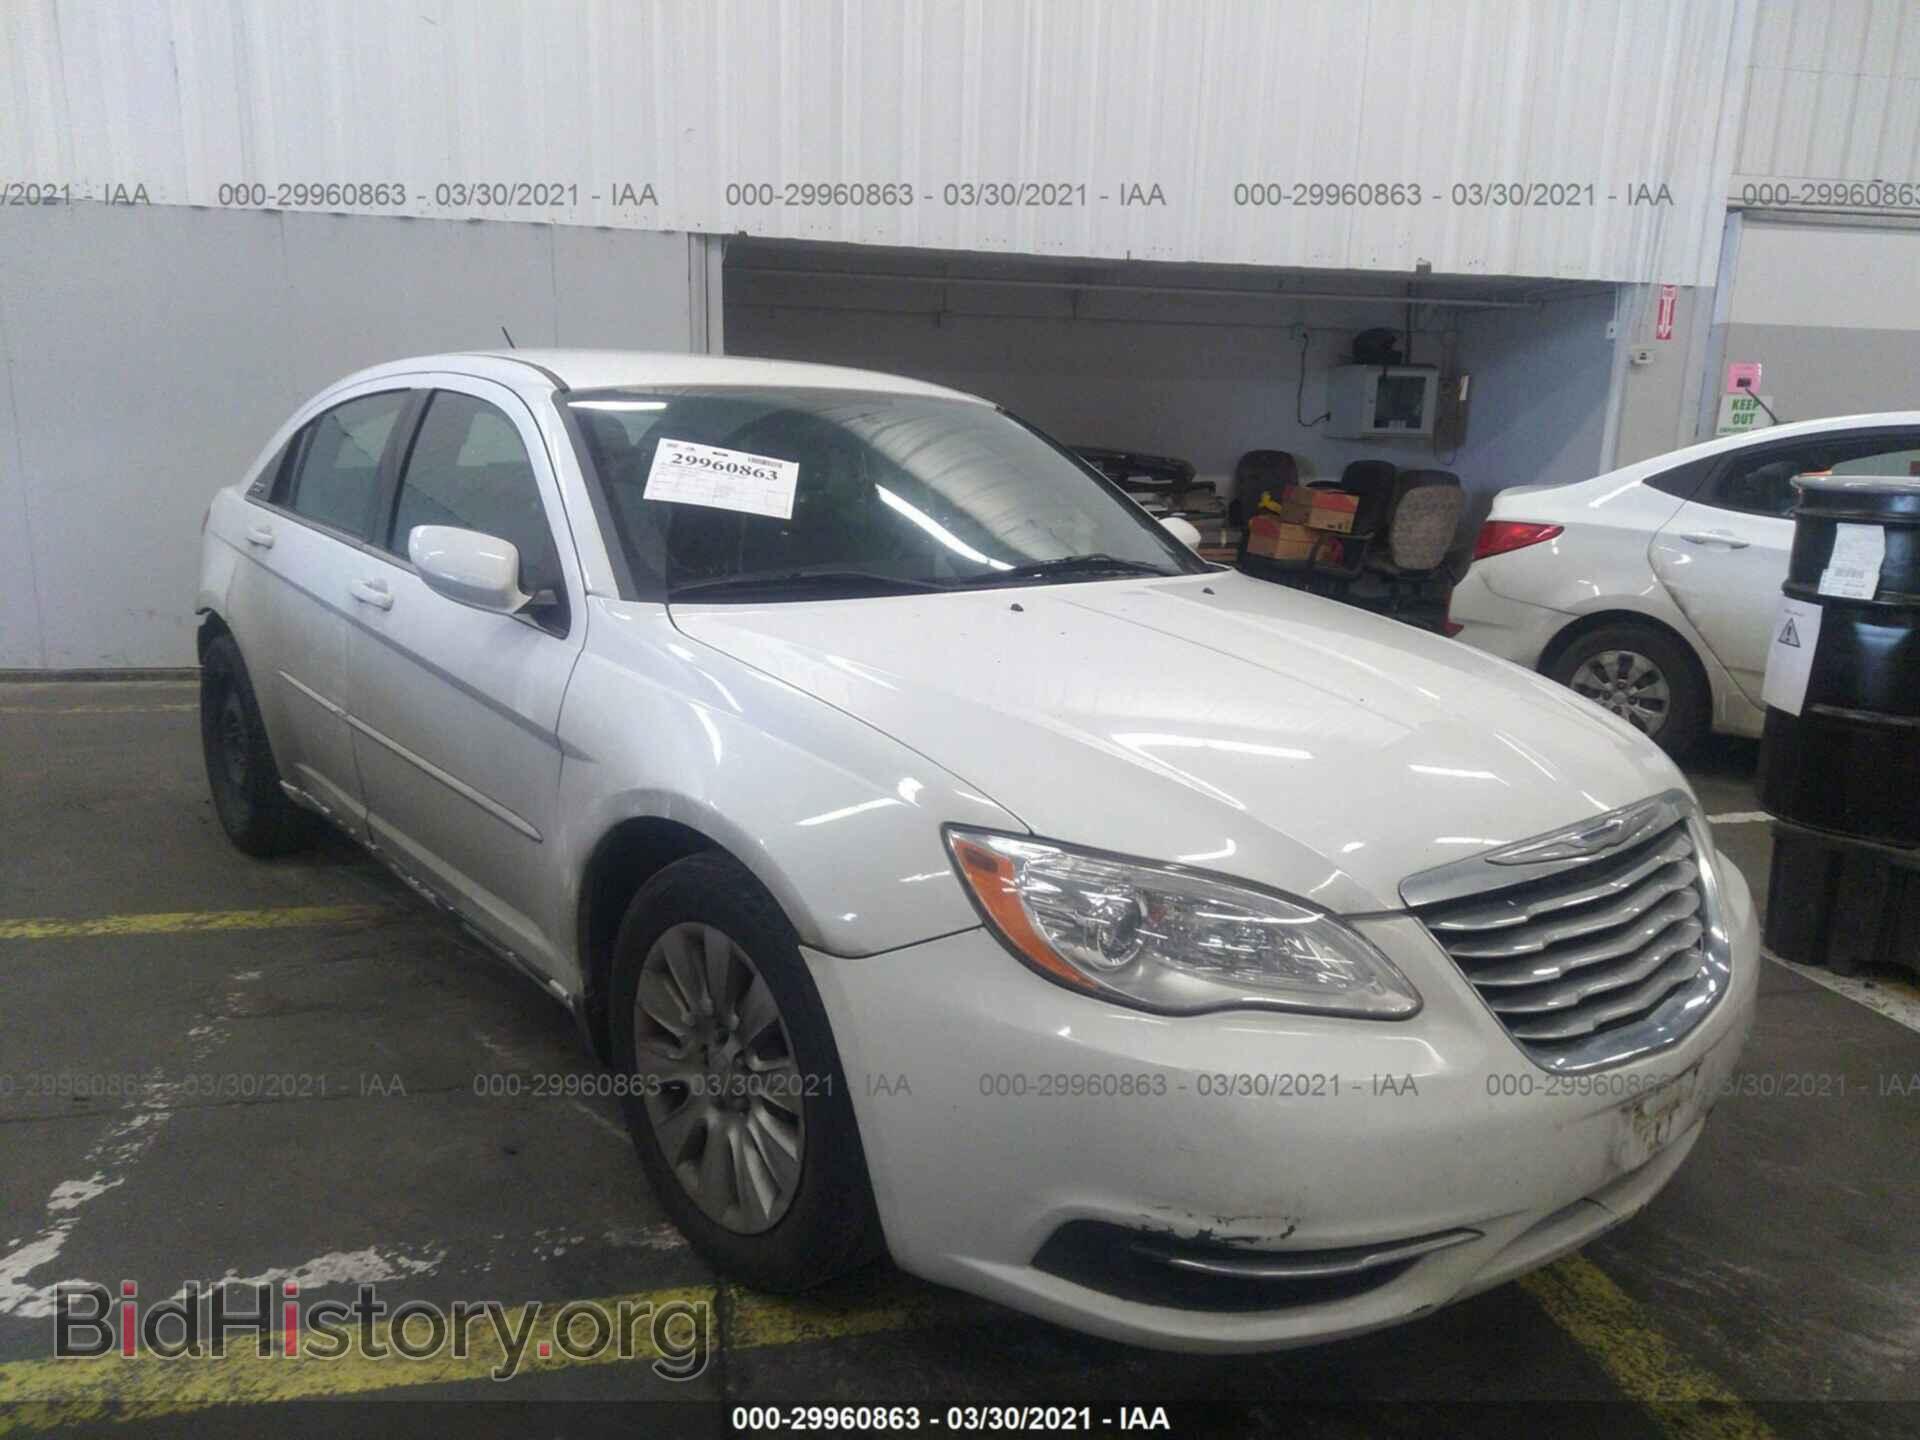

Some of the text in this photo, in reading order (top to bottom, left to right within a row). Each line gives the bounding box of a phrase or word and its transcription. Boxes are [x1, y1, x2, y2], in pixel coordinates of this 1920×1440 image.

[1731, 399, 1761, 411] KEEP
[1732, 413, 1756, 425] OUT
[671, 453, 778, 481] 29960863
